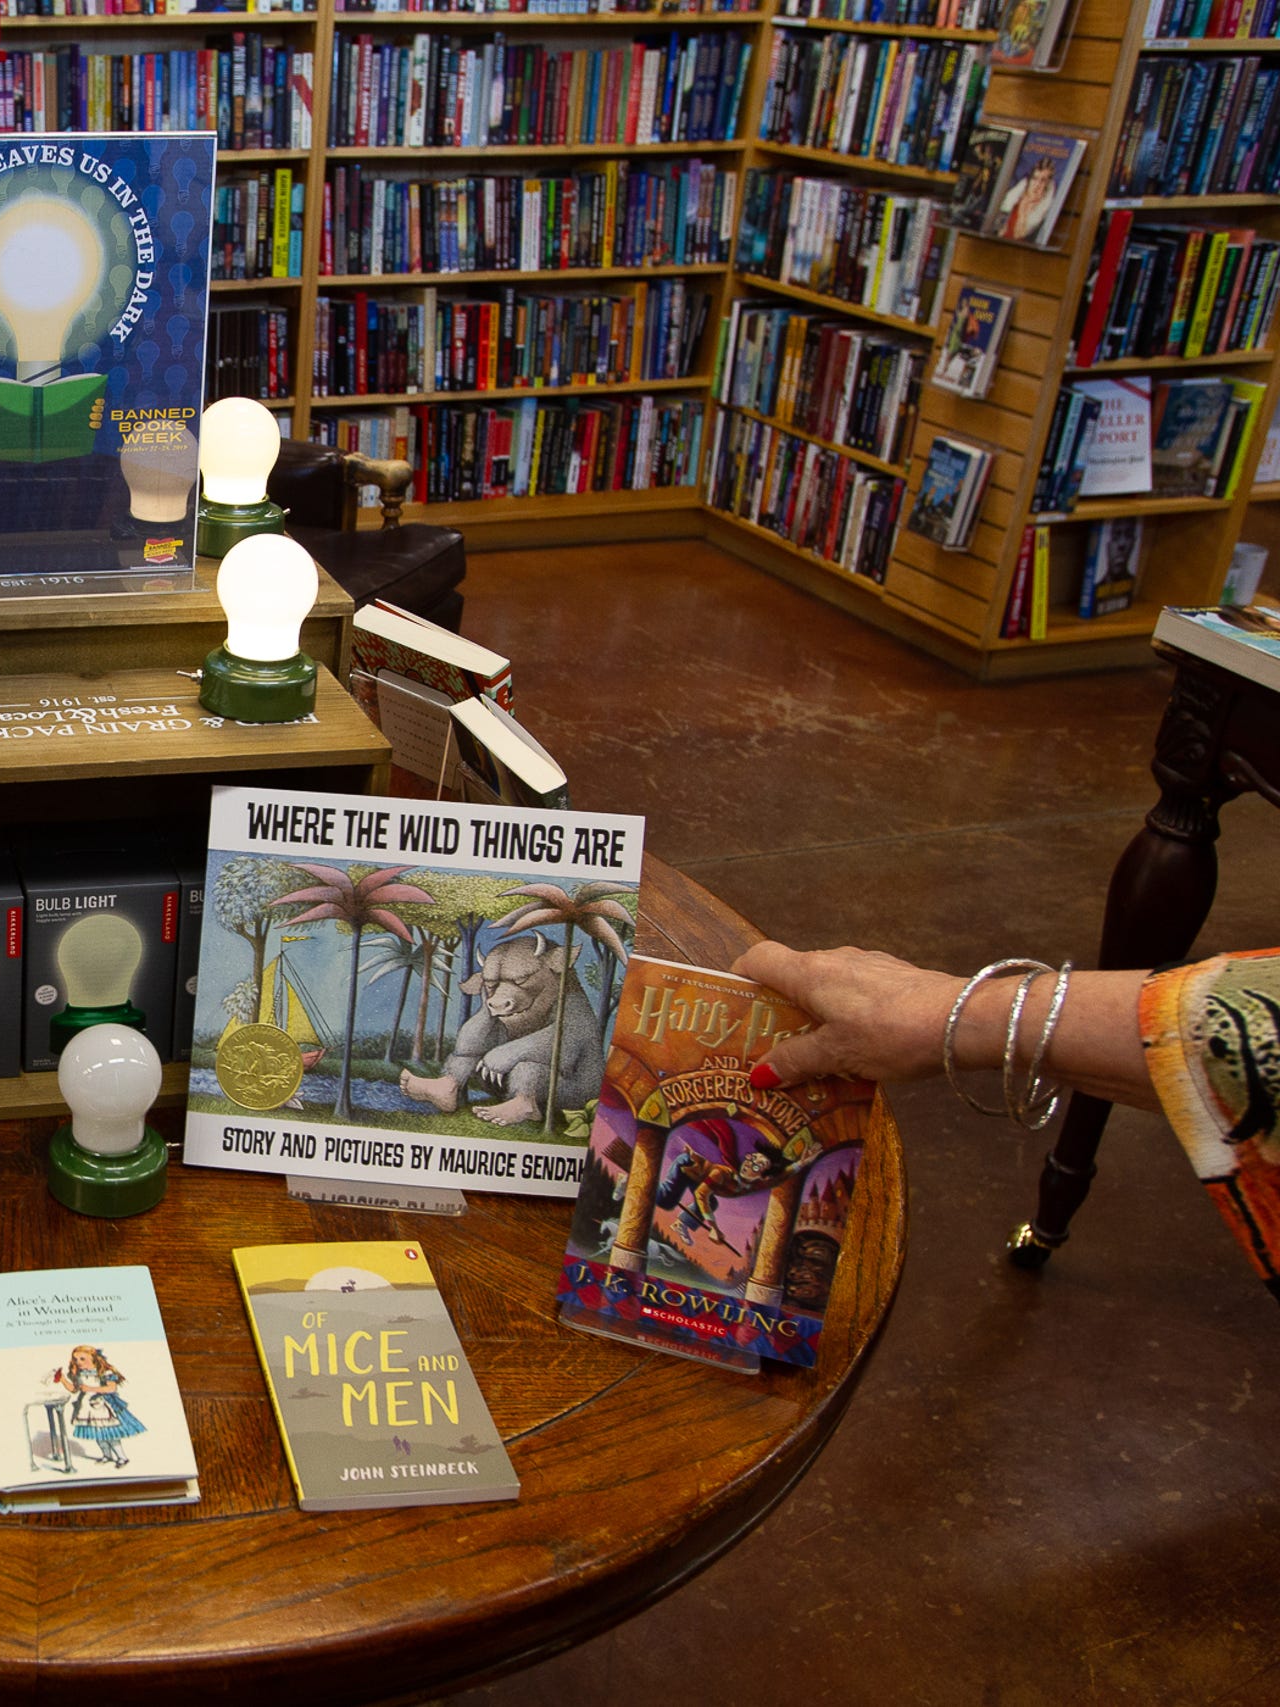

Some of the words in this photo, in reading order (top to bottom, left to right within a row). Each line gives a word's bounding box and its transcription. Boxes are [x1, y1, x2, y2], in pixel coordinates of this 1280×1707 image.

[79, 154, 112, 183] US
[108, 176, 138, 209] IN
[278, 196, 288, 238] SLAUGHTER
[129, 208, 154, 264] THE
[110, 271, 153, 343] DARK
[111, 408, 196, 420] BANNED
[1099, 414, 1146, 428] ELLER
[119, 420, 187, 432] BOOKS
[122, 432, 182, 444] WEEK
[1098, 432, 1139, 443] PORT
[0, 579, 32, 589] est.
[39, 575, 85, 587] 1916
[40, 697, 83, 708] 1916
[92, 695, 117, 704] est.
[86, 718, 192, 735] GRAIN
[247, 802, 335, 845] WHERE
[343, 809, 390, 849] THE
[399, 814, 460, 855] WILD
[470, 819, 565, 864] THINGS
[573, 827, 626, 868] ARE
[36, 898, 71, 911] BULB
[75, 895, 117, 909] LIGHT
[632, 985, 742, 1048] Harry
[700, 1056, 739, 1070] AND
[661, 1073, 754, 1109] SORCERER'S
[757, 1088, 810, 1137] STONE
[222, 1127, 276, 1155] STORY
[280, 1133, 317, 1159] AND
[324, 1136, 404, 1168] PICTURES
[409, 1144, 431, 1171] BY
[439, 1148, 517, 1178] MAURICE
[6, 1295, 46, 1306] Alice's
[51, 1294, 122, 1304] Adventures
[34, 1304, 113, 1315] Wonderland
[575, 1263, 591, 1285] J.
[603, 1273, 628, 1295] K.
[638, 1281, 800, 1337] ROWLING
[302, 1312, 328, 1329] OF
[652, 1308, 726, 1335] SCHOLASTIC
[284, 1330, 409, 1378] MICE
[417, 1354, 459, 1372] AND
[342, 1380, 459, 1427] MEN
[340, 1463, 385, 1481] JOHN
[390, 1460, 479, 1480] STEINBECK
